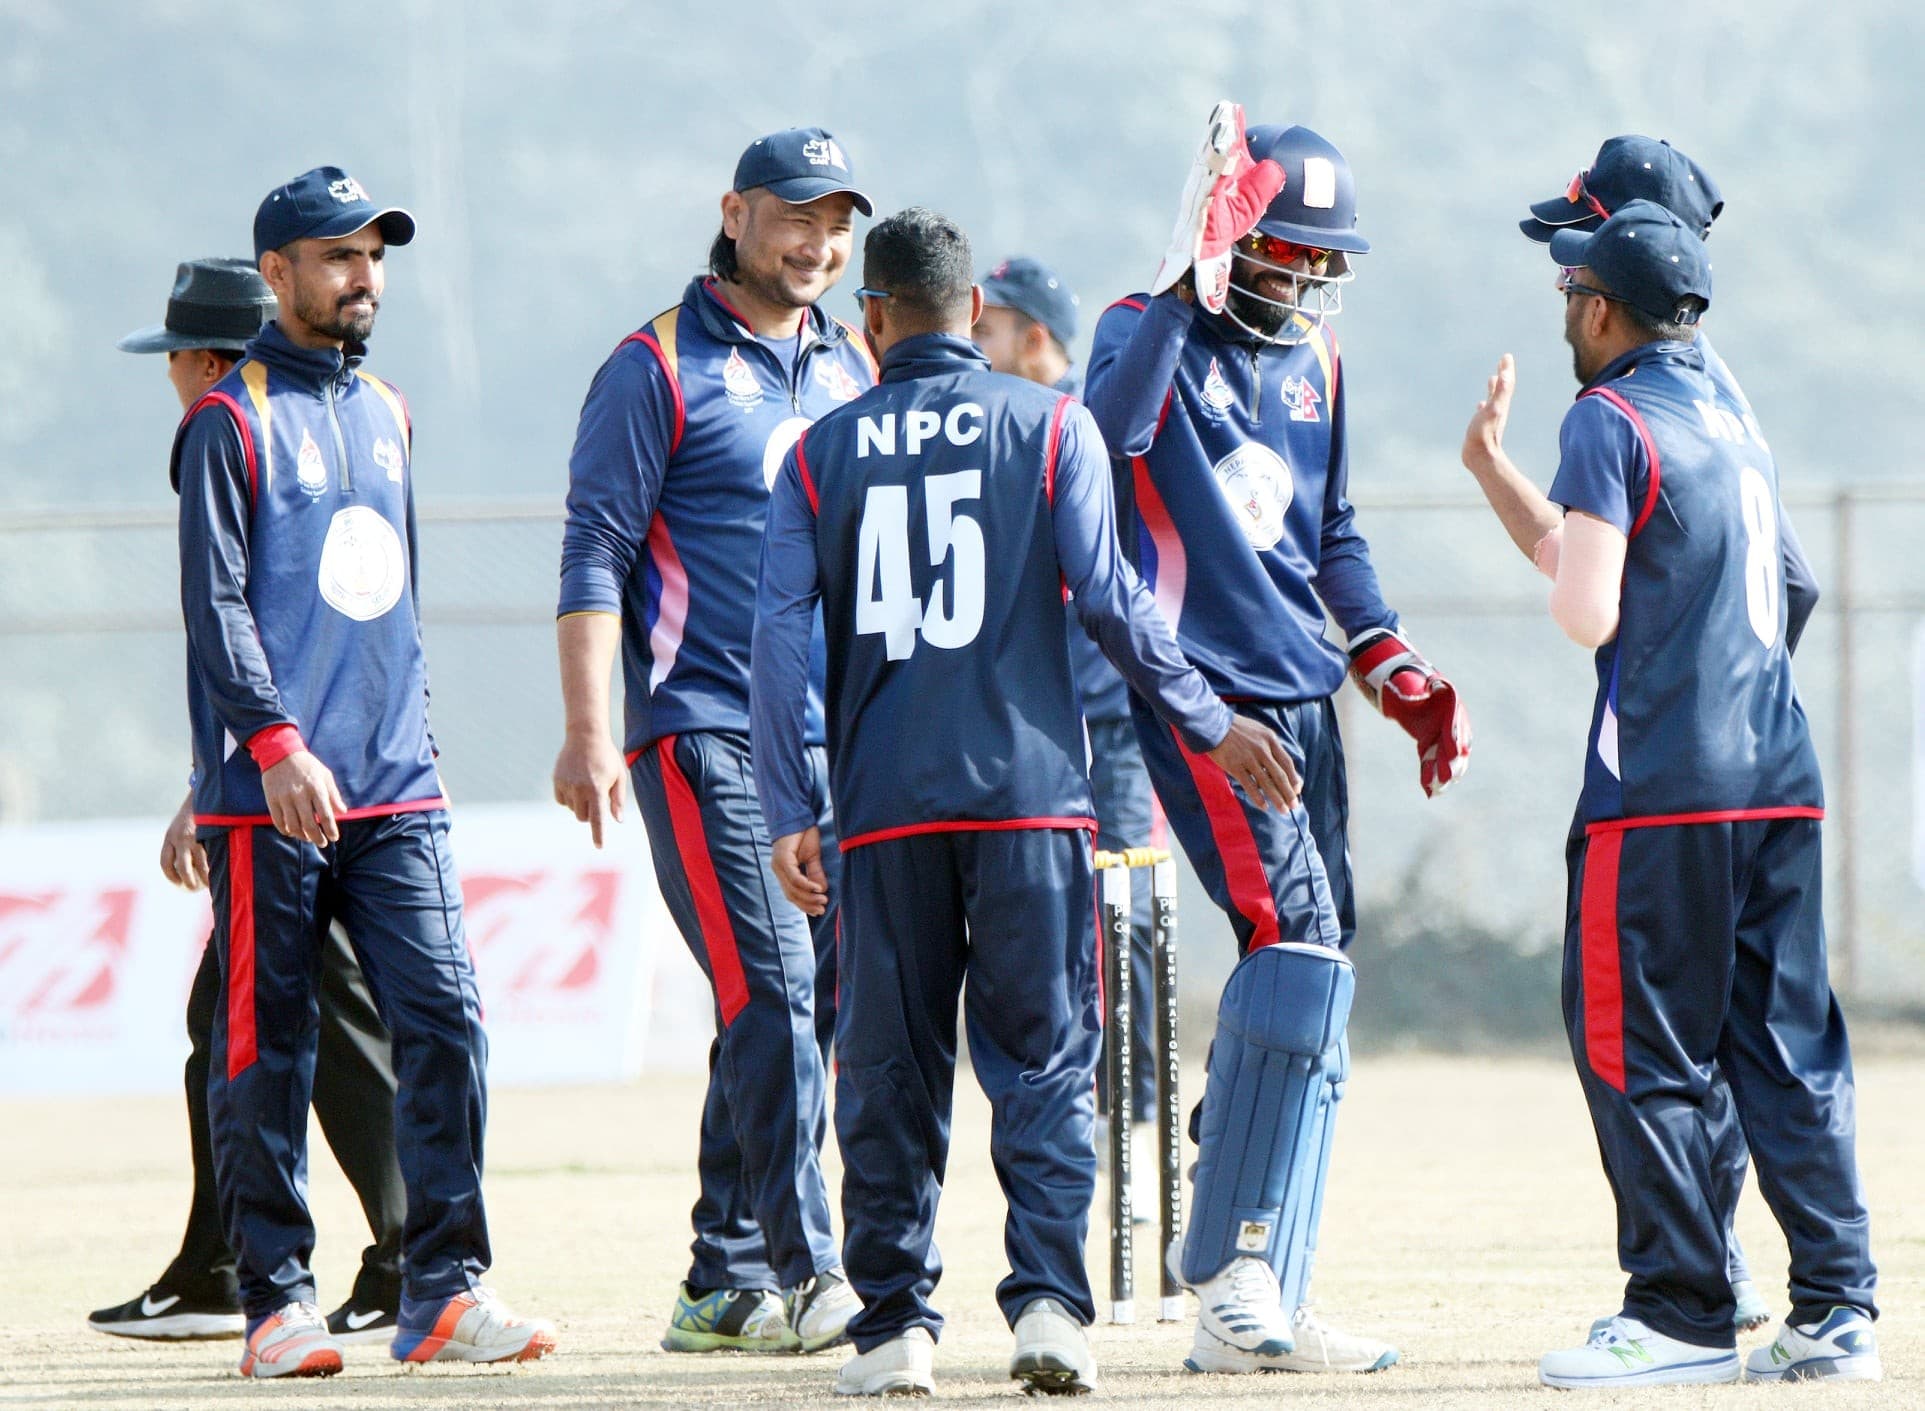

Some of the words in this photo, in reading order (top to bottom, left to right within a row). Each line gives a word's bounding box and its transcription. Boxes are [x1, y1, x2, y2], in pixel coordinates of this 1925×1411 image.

[857, 402, 984, 458] NPC
[856, 469, 986, 662] 45
[1740, 466, 1779, 650] 8
[1120, 949, 1129, 991] MENS
[1166, 943, 1176, 986] MENS
[1120, 1003, 1130, 1088] NATIONAL
[1168, 997, 1178, 1083] NATIONAL
[1121, 1099, 1130, 1174] CRICKET
[1169, 1093, 1179, 1169] CRICKET
[1121, 1184, 1132, 1293] TOURNAMENT
[1170, 1179, 1181, 1242] TOURNA
